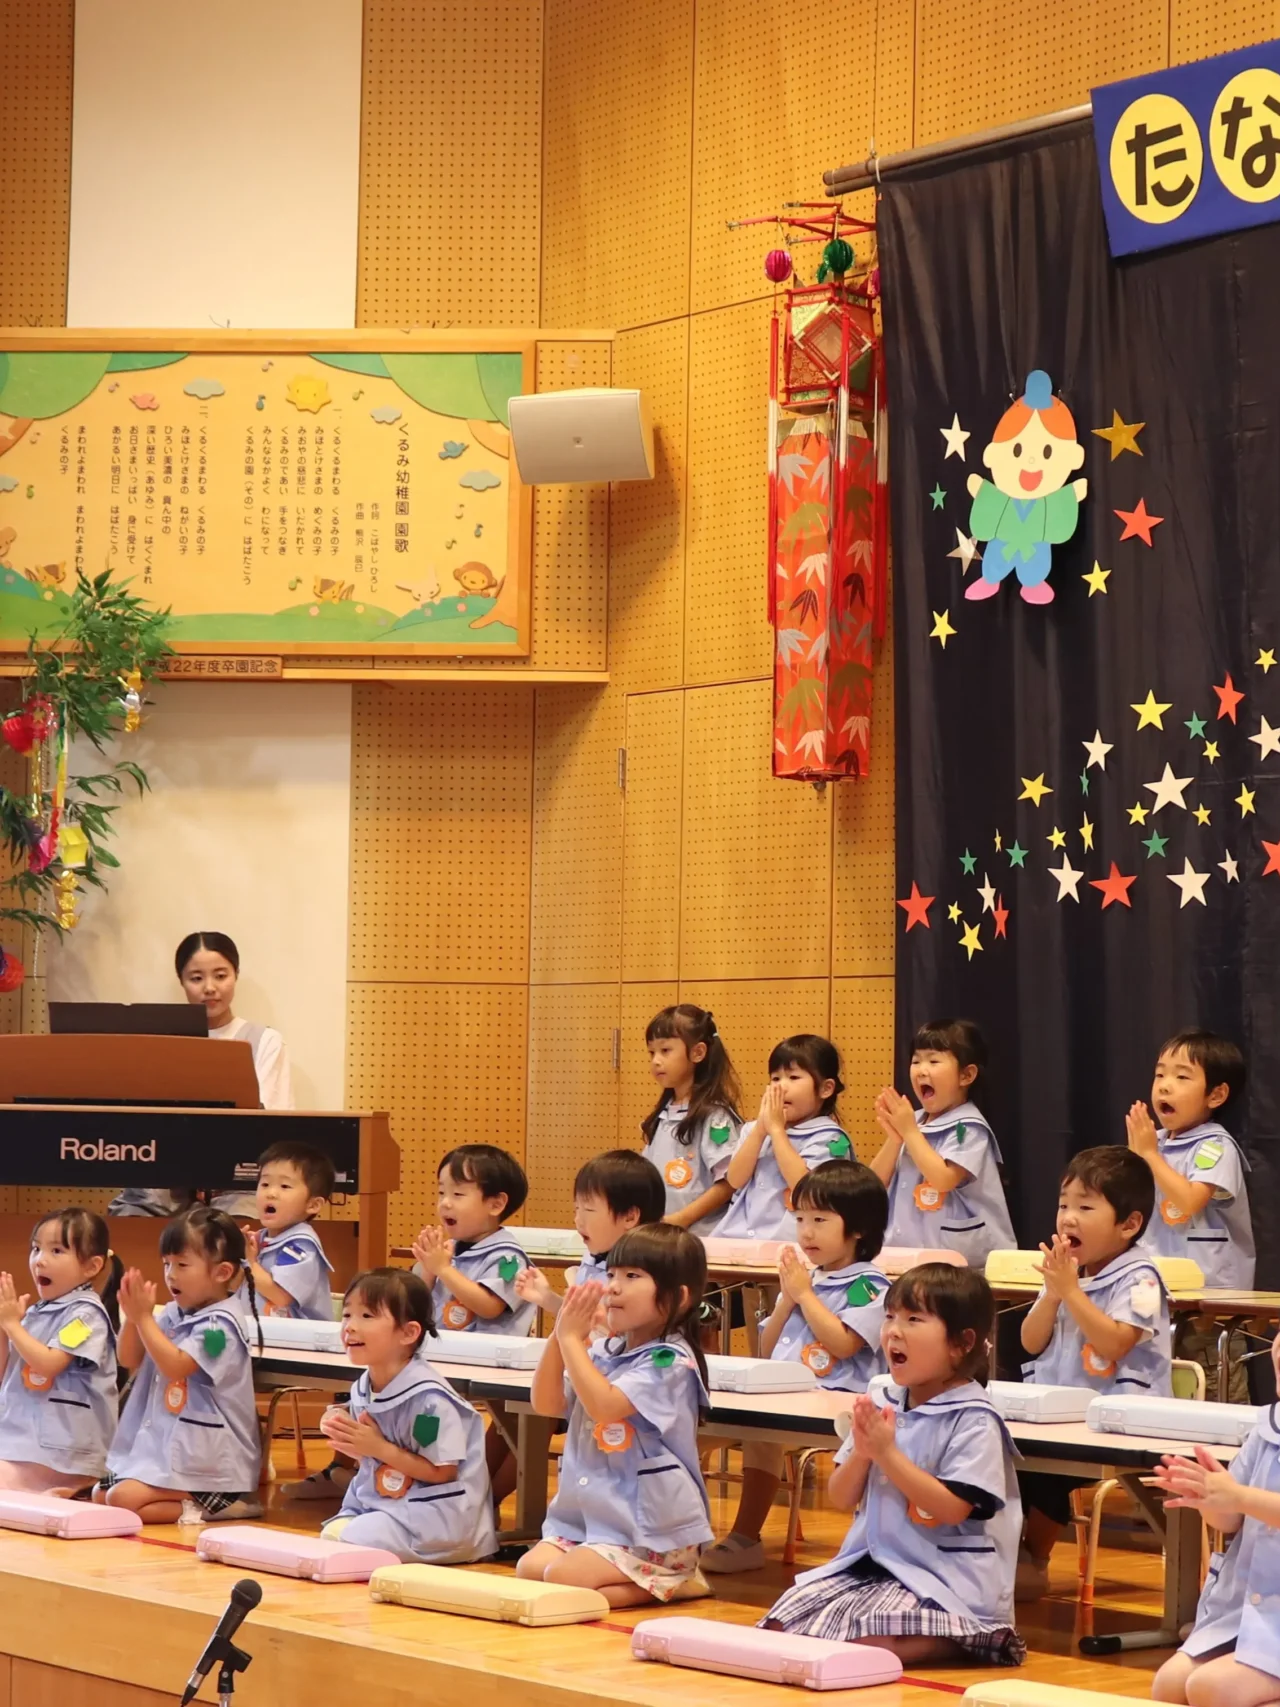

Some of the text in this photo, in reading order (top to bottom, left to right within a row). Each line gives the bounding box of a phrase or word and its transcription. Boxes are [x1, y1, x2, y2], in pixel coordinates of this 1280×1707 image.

[60, 425, 69, 475] くるみの子
[76, 425, 87, 494] まわれよまわれ
[111, 426, 121, 494] あかるい明日に
[198, 426, 207, 495] くるくるまわる
[314, 426, 324, 495] みほとけさまの
[332, 426, 341, 495] くるくるまわる
[179, 426, 190, 555] みほとけさまの ねがいの子
[261, 426, 272, 555] みんななかよく わになって
[394, 422, 410, 553] くるみ幼稚園 園歌
[196, 506, 206, 556] くるみの子
[330, 507, 340, 556] くるみの子
[60, 1137, 156, 1162] Roland
